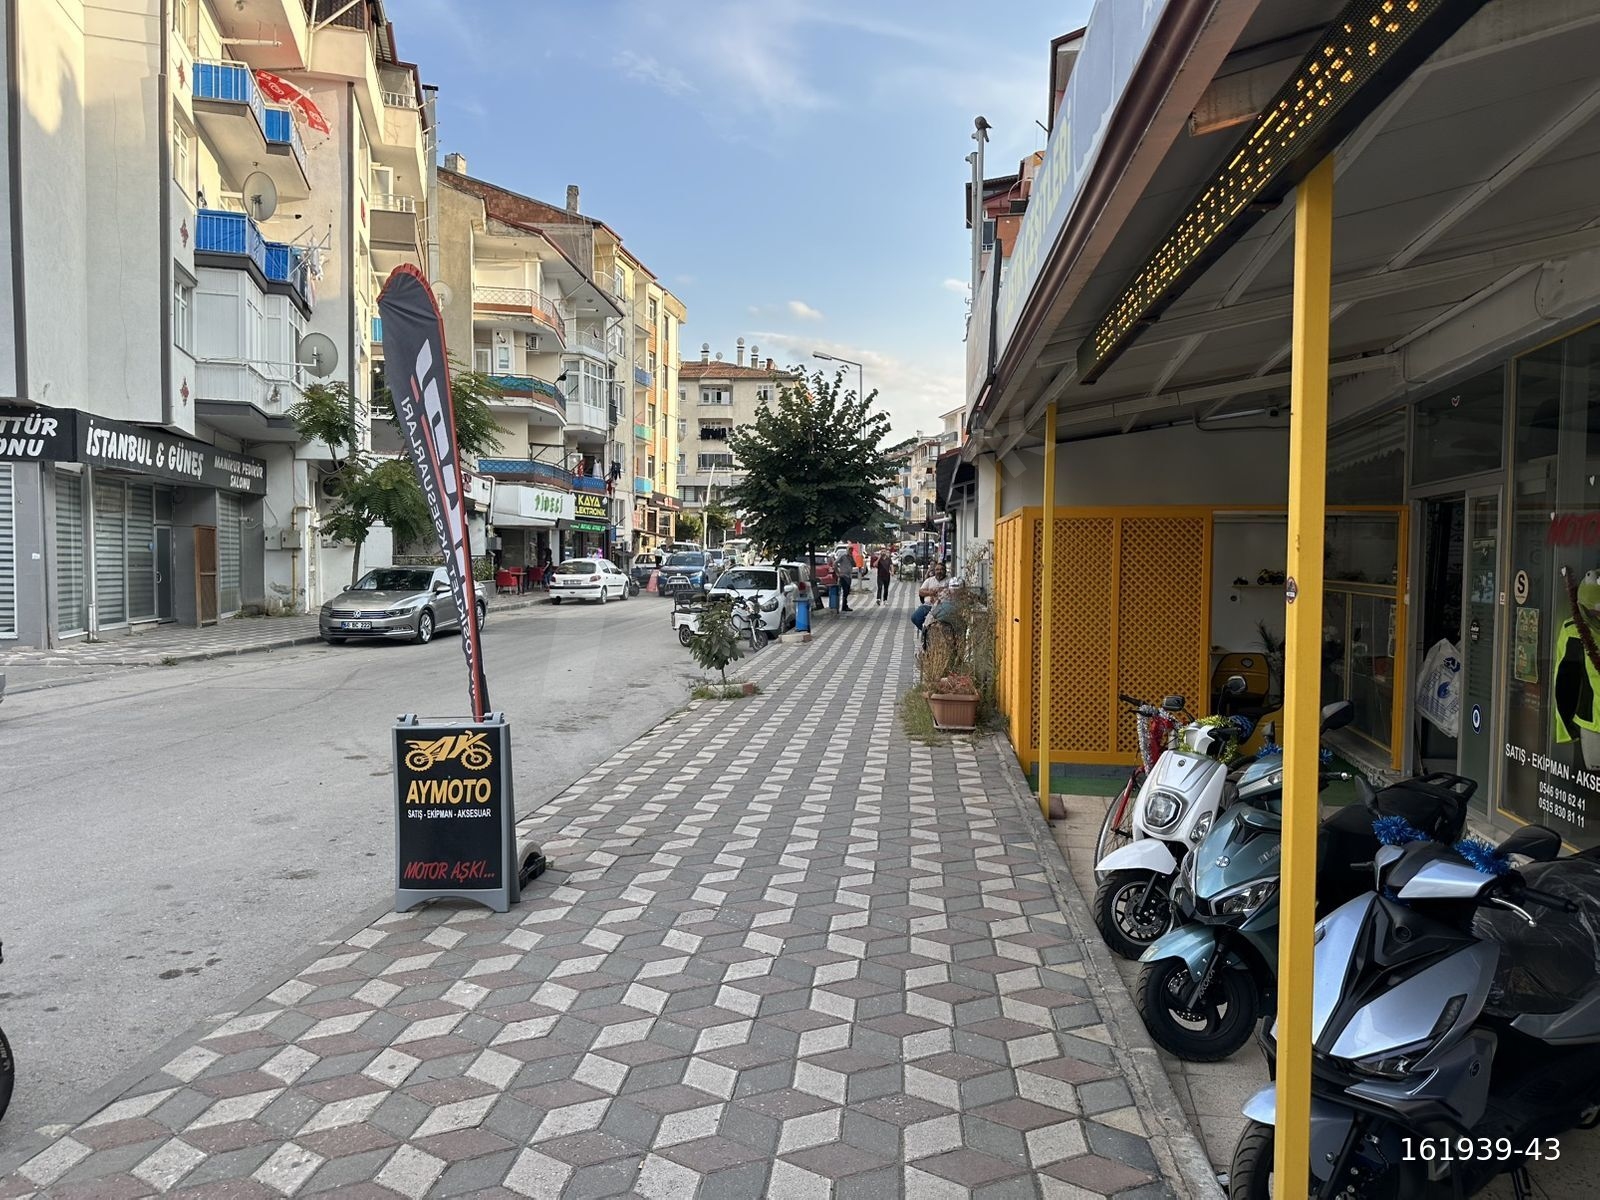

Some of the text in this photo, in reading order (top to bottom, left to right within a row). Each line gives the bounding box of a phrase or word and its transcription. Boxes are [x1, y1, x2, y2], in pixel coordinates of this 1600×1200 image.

[86, 419, 204, 480] İSTANBUL & GÜNEŞ
[230, 474, 250, 490] SALONU
[578, 494, 601, 508] KAYA
[1505, 743, 1526, 766] SATIŞ
[1532, 753, 1569, 780] EKİPMAN
[406, 777, 491, 804] AYMOTO
[1539, 781, 1586, 811] 0546 910 62 41
[407, 809, 423, 821] SATIŞ
[427, 807, 453, 819] EKİPMAN
[457, 808, 491, 819] AKSESUAR
[1538, 797, 1585, 828] 0535 830 81 11
[404, 861, 448, 880] MOTOR
